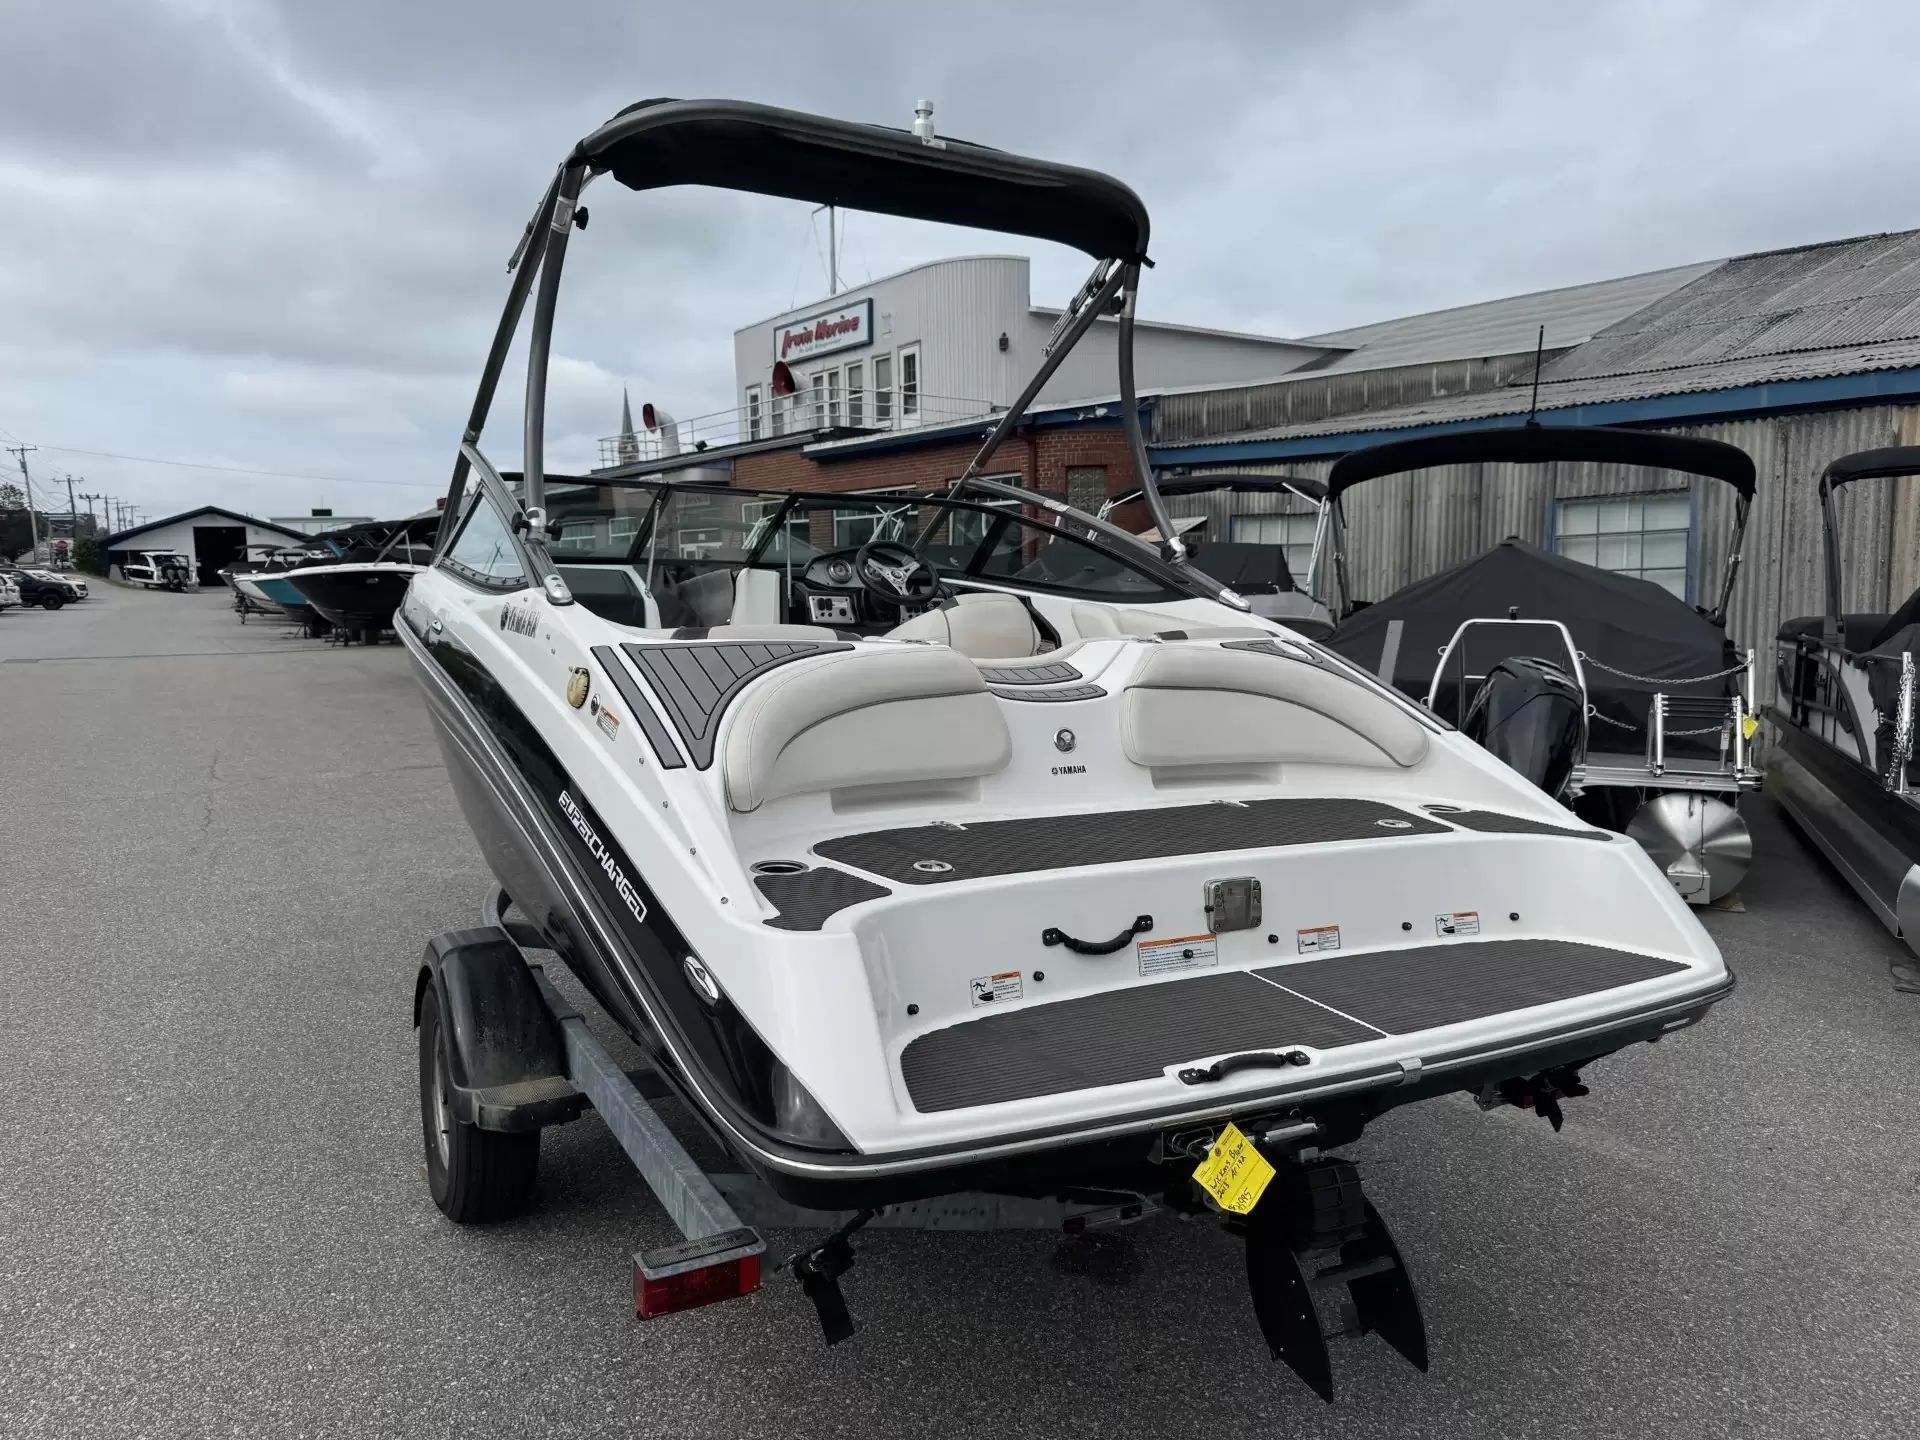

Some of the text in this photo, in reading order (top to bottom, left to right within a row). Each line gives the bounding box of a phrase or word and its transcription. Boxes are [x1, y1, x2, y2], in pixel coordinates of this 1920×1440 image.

[507, 606, 540, 639] YAMAHA
[1058, 765, 1087, 775] YAMAHA
[558, 790, 648, 924] SUPERCHARGED
